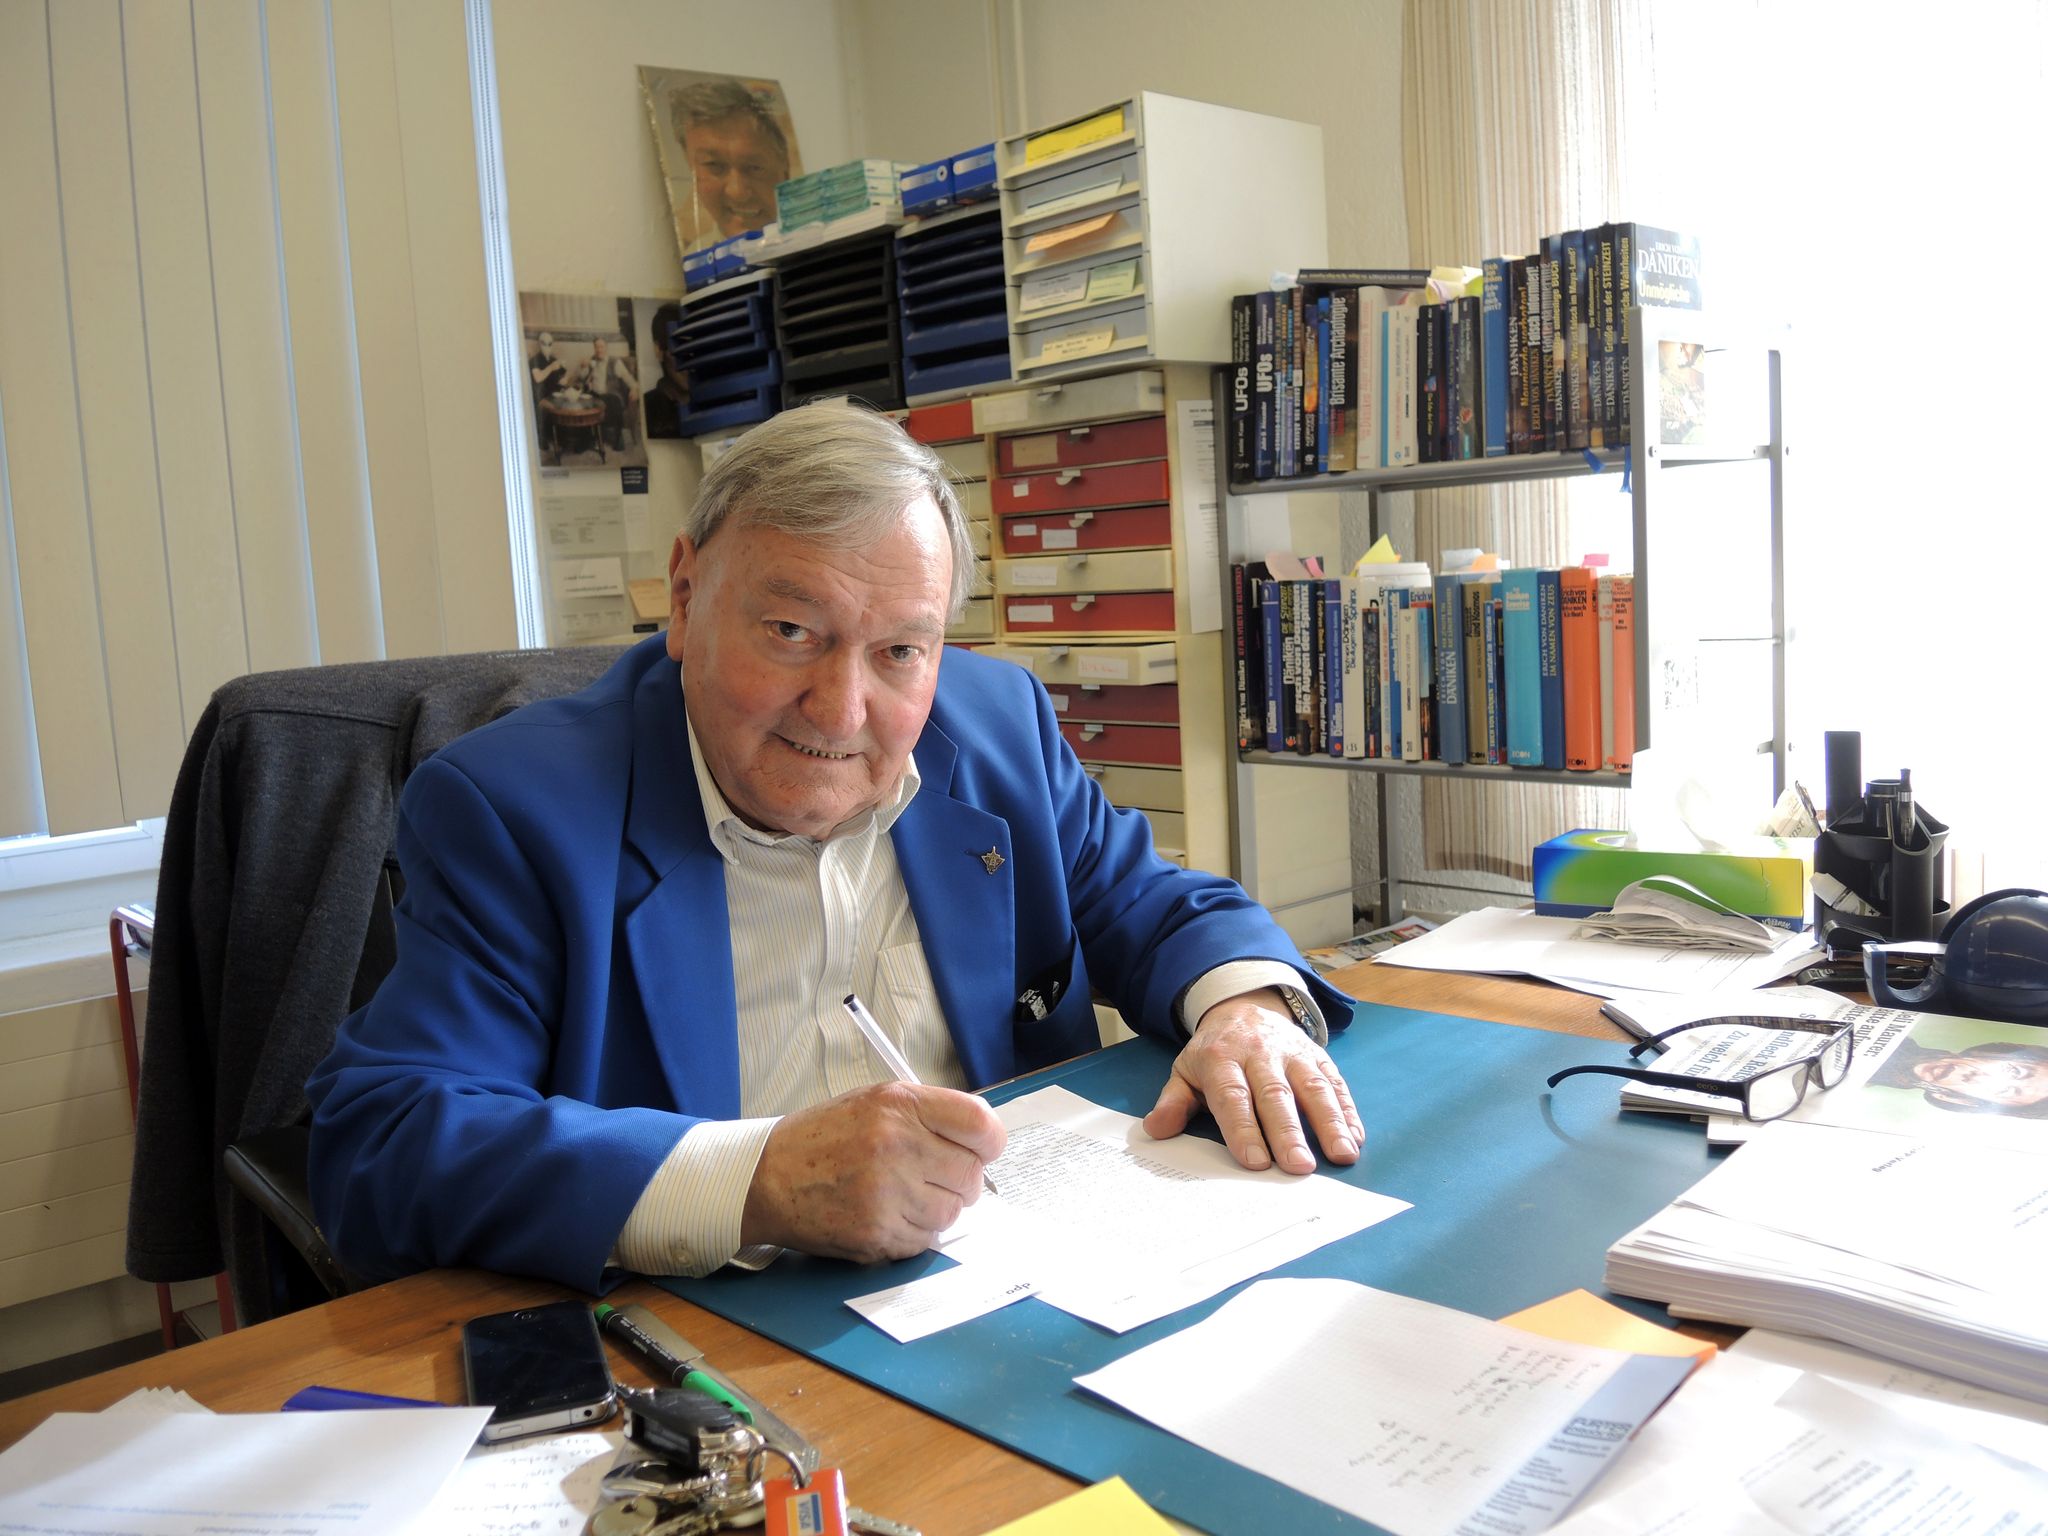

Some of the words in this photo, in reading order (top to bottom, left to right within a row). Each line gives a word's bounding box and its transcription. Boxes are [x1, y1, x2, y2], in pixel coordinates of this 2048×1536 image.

[1603, 241, 1612, 289] STEINZEIT
[1620, 236, 1629, 290] Wahrheiten
[1637, 247, 1698, 280] DÄNIKEN
[1639, 279, 1691, 305] Unmögliche
[1328, 296, 1347, 360] Archäologie
[1529, 315, 1541, 347] Falsch
[1235, 367, 1249, 411] UFOs
[1256, 353, 1273, 392] UFOs
[1329, 361, 1346, 405] Brisante
[1571, 362, 1581, 410] DÄNIKEN
[1592, 359, 1603, 407] DÄNIKEN
[1605, 356, 1616, 406] DÄNIKEN
[1301, 583, 1311, 629] Sphinx
[1473, 591, 1481, 621] Kosmos
[1547, 583, 1555, 606] ZEUS
[1293, 584, 1301, 645] Däniken
[1301, 629, 1310, 652] der
[1549, 630, 1557, 663] NAMEN
[1283, 636, 1295, 684] Däniken
[1302, 652, 1312, 693] Augen
[1541, 649, 1549, 677] ERICH
[1549, 664, 1557, 677] IM
[1445, 651, 1458, 705] DÄNIKEN
[1302, 693, 1311, 714] Die
[1567, 758, 1588, 766] ECON
[1694, 1041, 1734, 1063] weich
[1726, 1030, 1751, 1041] Zu
[1863, 1023, 1907, 1057] Maurer:
[797, 1500, 813, 1531] VISA
